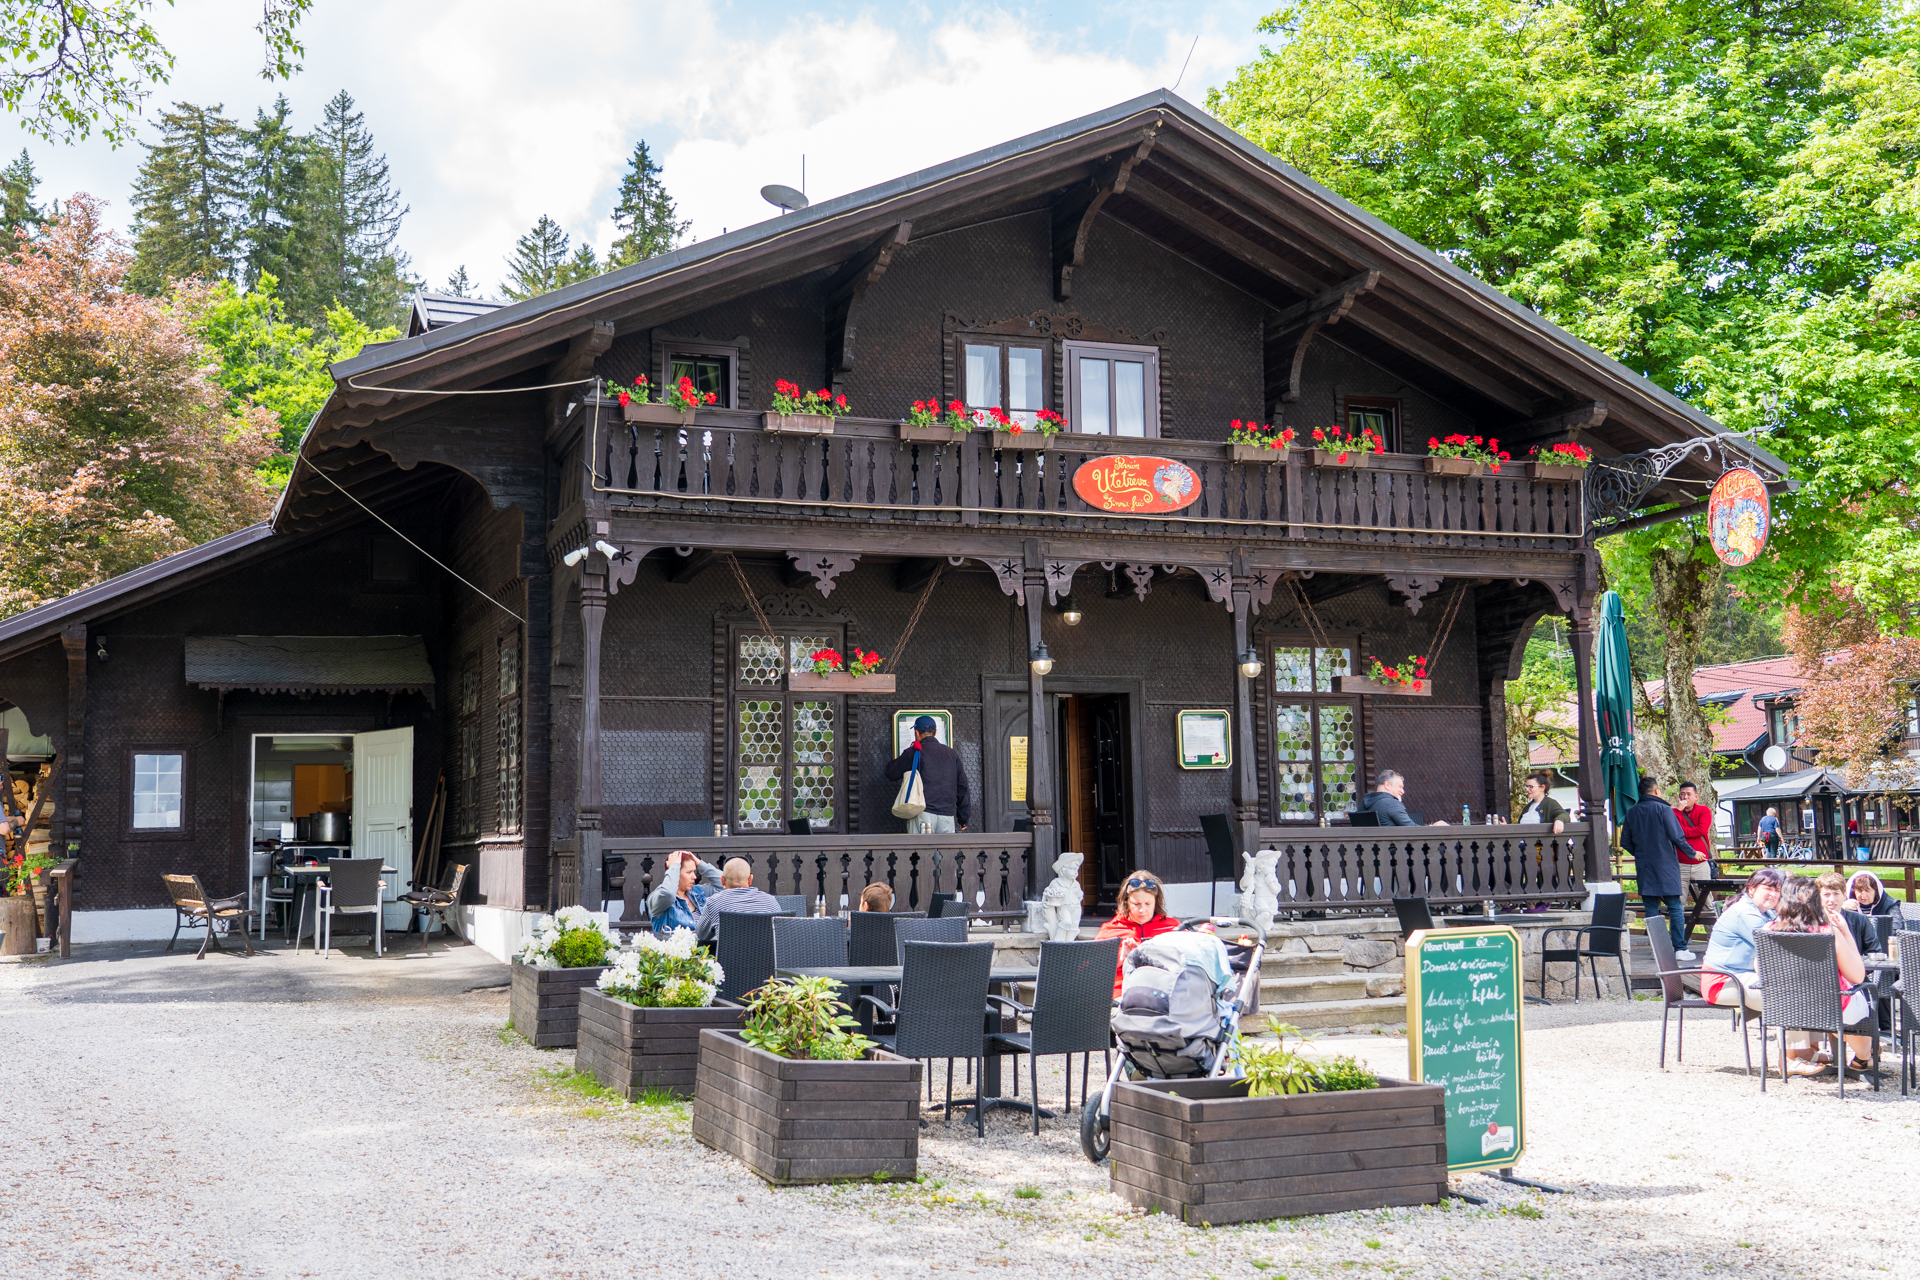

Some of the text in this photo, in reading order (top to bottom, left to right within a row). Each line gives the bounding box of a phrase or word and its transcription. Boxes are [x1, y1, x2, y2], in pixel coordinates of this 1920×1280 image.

[1423, 940, 1464, 952] Pilsner Urquell
[1471, 985, 1506, 1006] biftek
[1493, 1039, 1500, 1048] s
